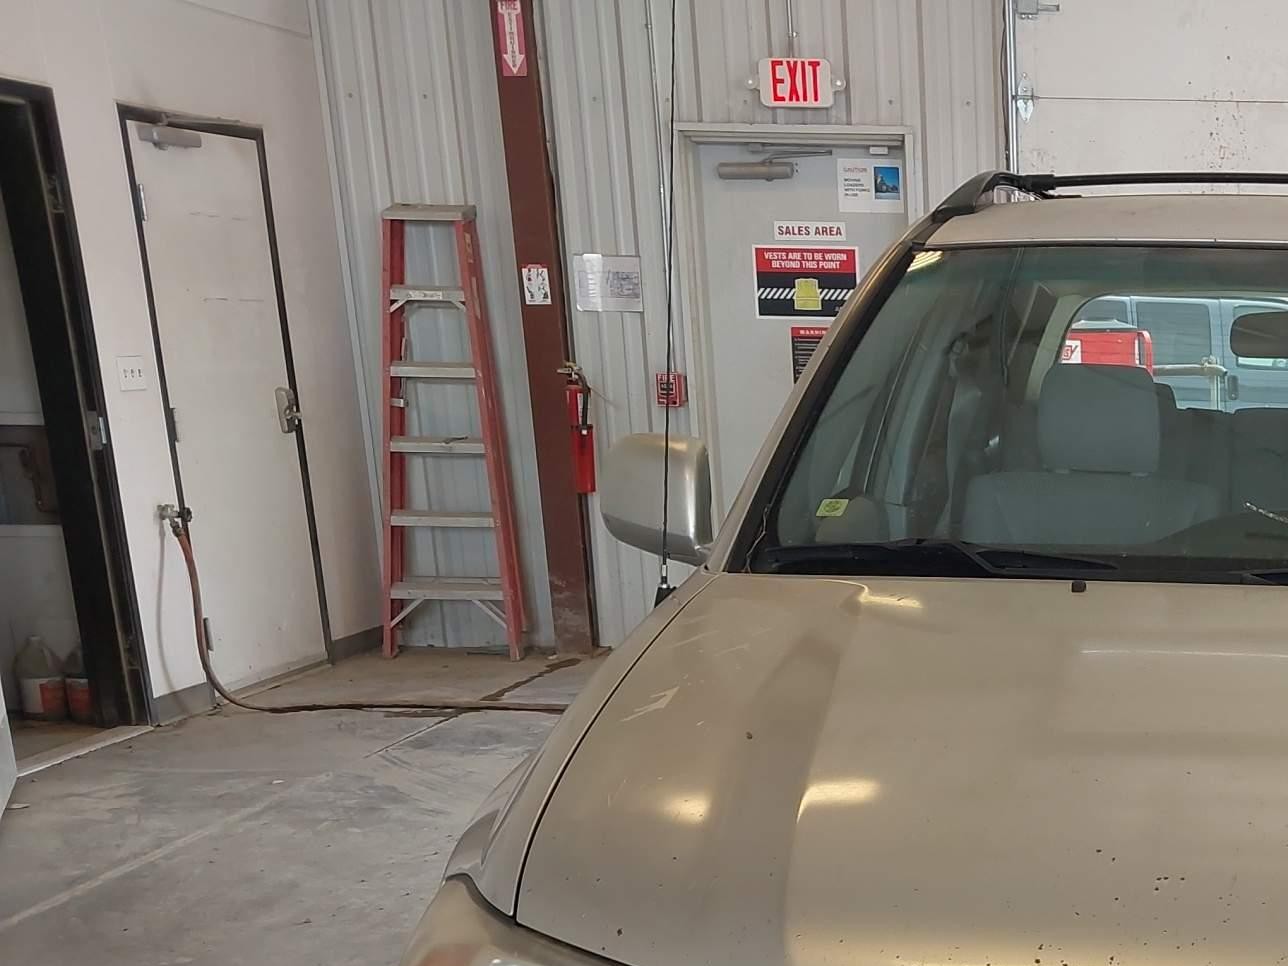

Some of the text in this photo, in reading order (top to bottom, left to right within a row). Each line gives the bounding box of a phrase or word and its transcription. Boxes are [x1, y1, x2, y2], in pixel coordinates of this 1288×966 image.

[770, 60, 821, 102] EXIT
[777, 225, 843, 237] SALES AREA
[763, 251, 787, 260] VESTS
[788, 252, 802, 260] ARE
[824, 253, 848, 261] WORN
[771, 260, 841, 269] BEYOND THIS POINT
